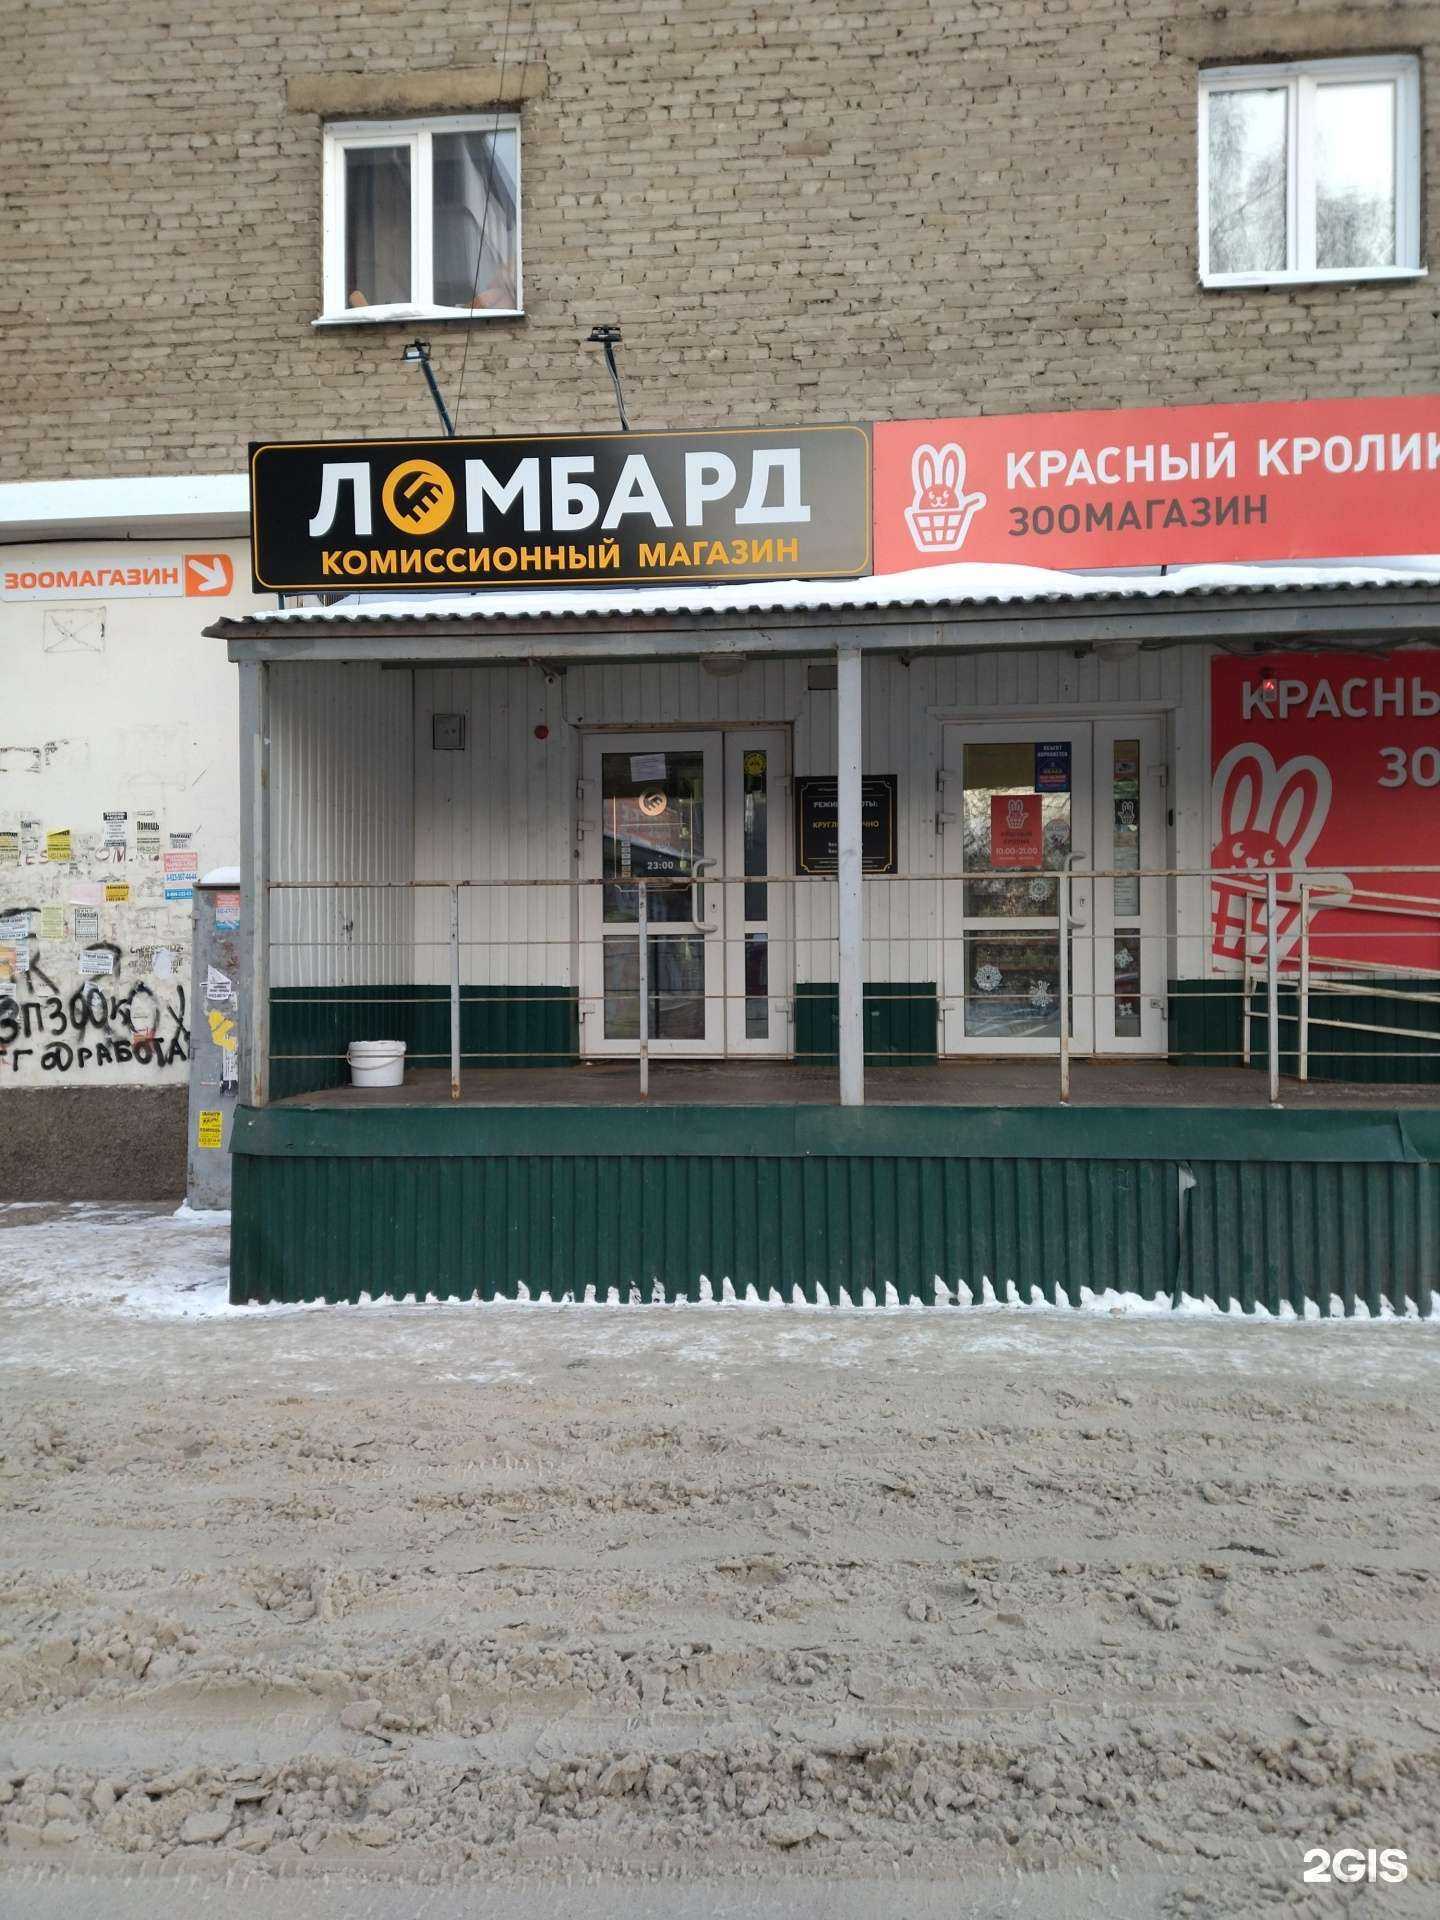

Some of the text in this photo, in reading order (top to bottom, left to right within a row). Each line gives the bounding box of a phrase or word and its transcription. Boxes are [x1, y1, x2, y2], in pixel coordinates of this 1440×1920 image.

[1007, 432, 1235, 490] КРАСНЫЙ
[309, 448, 811, 537] ЛОМБАРД
[1008, 495, 1267, 536] ЗООМАГАЗИН
[322, 537, 798, 575] КОМИССИОННЫЙ МАГАЗИН
[4, 567, 178, 589] ЗООМАГАЗИН
[647, 861, 674, 870] 23:00
